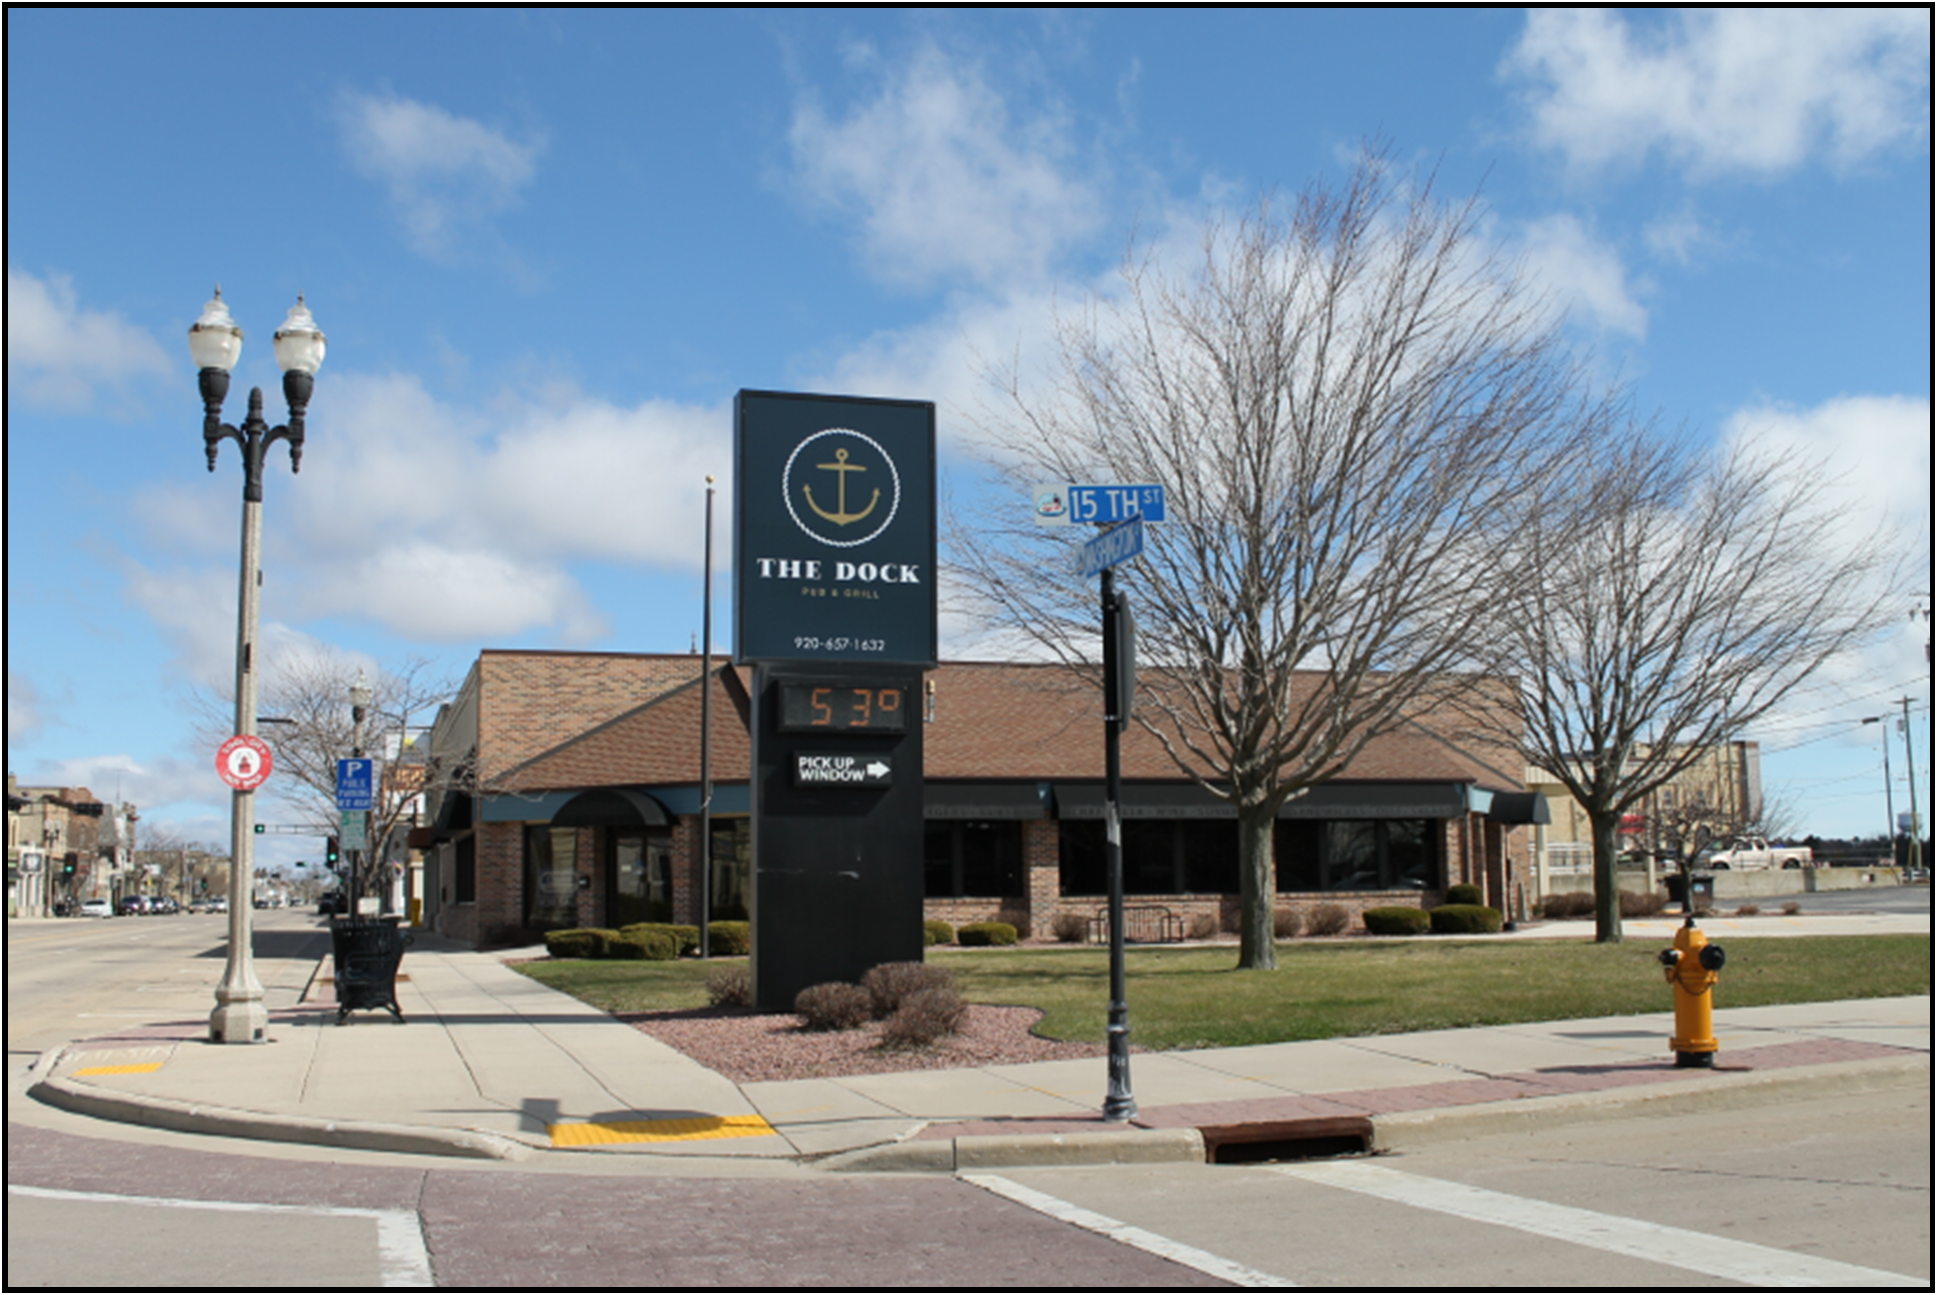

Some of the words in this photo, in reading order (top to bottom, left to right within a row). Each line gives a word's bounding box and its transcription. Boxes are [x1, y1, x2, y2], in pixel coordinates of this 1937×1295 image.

[1071, 490, 1098, 519] 15
[1105, 489, 1140, 518] TH
[1143, 488, 1161, 504] ST
[757, 558, 822, 580] THE
[835, 561, 920, 584] DOCK
[802, 587, 826, 597] PUB
[832, 588, 838, 598] &
[843, 589, 880, 599] GRILL
[794, 637, 886, 652] 920-657-1632
[347, 761, 363, 778] P
[798, 756, 833, 769] PICK
[834, 757, 855, 769] UP
[799, 769, 866, 782] WINDOW
